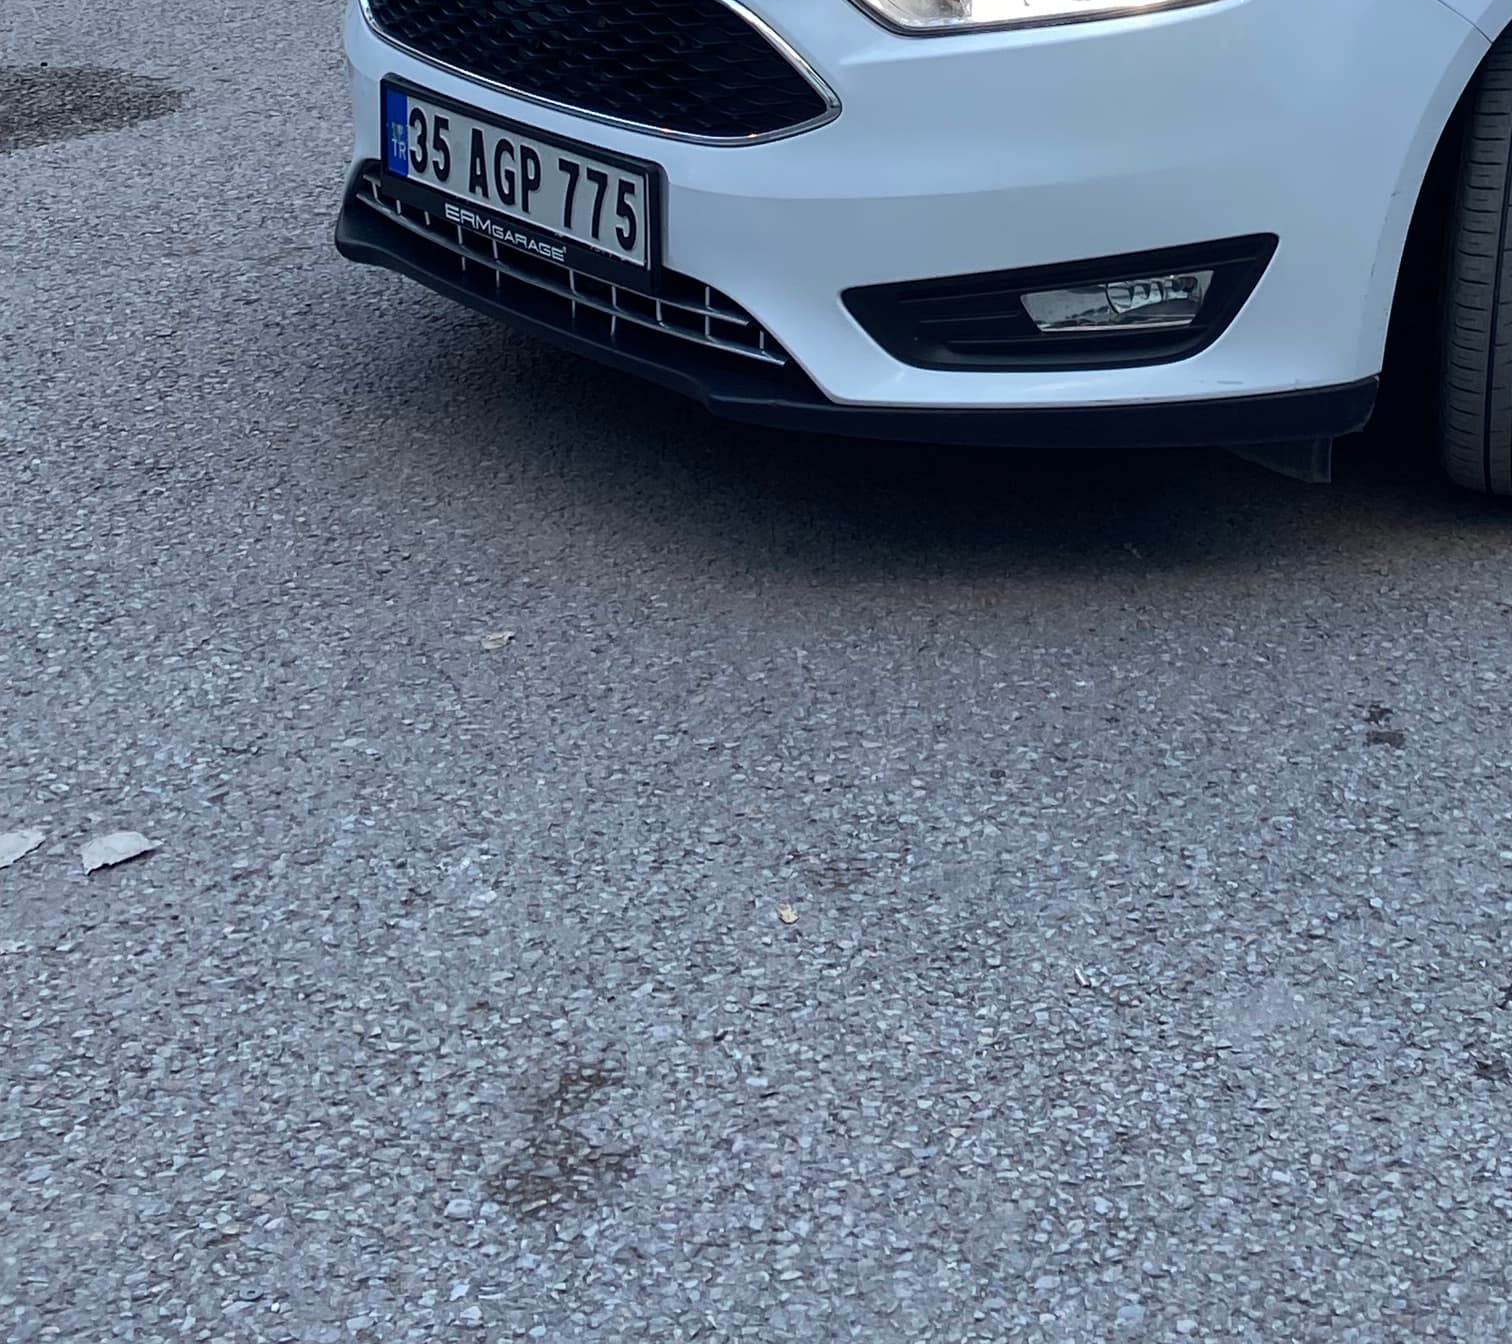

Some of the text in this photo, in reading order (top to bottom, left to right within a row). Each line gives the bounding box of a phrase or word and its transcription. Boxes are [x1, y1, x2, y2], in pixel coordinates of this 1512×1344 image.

[391, 137, 408, 162] TR
[408, 106, 638, 251] 35 AGP 775
